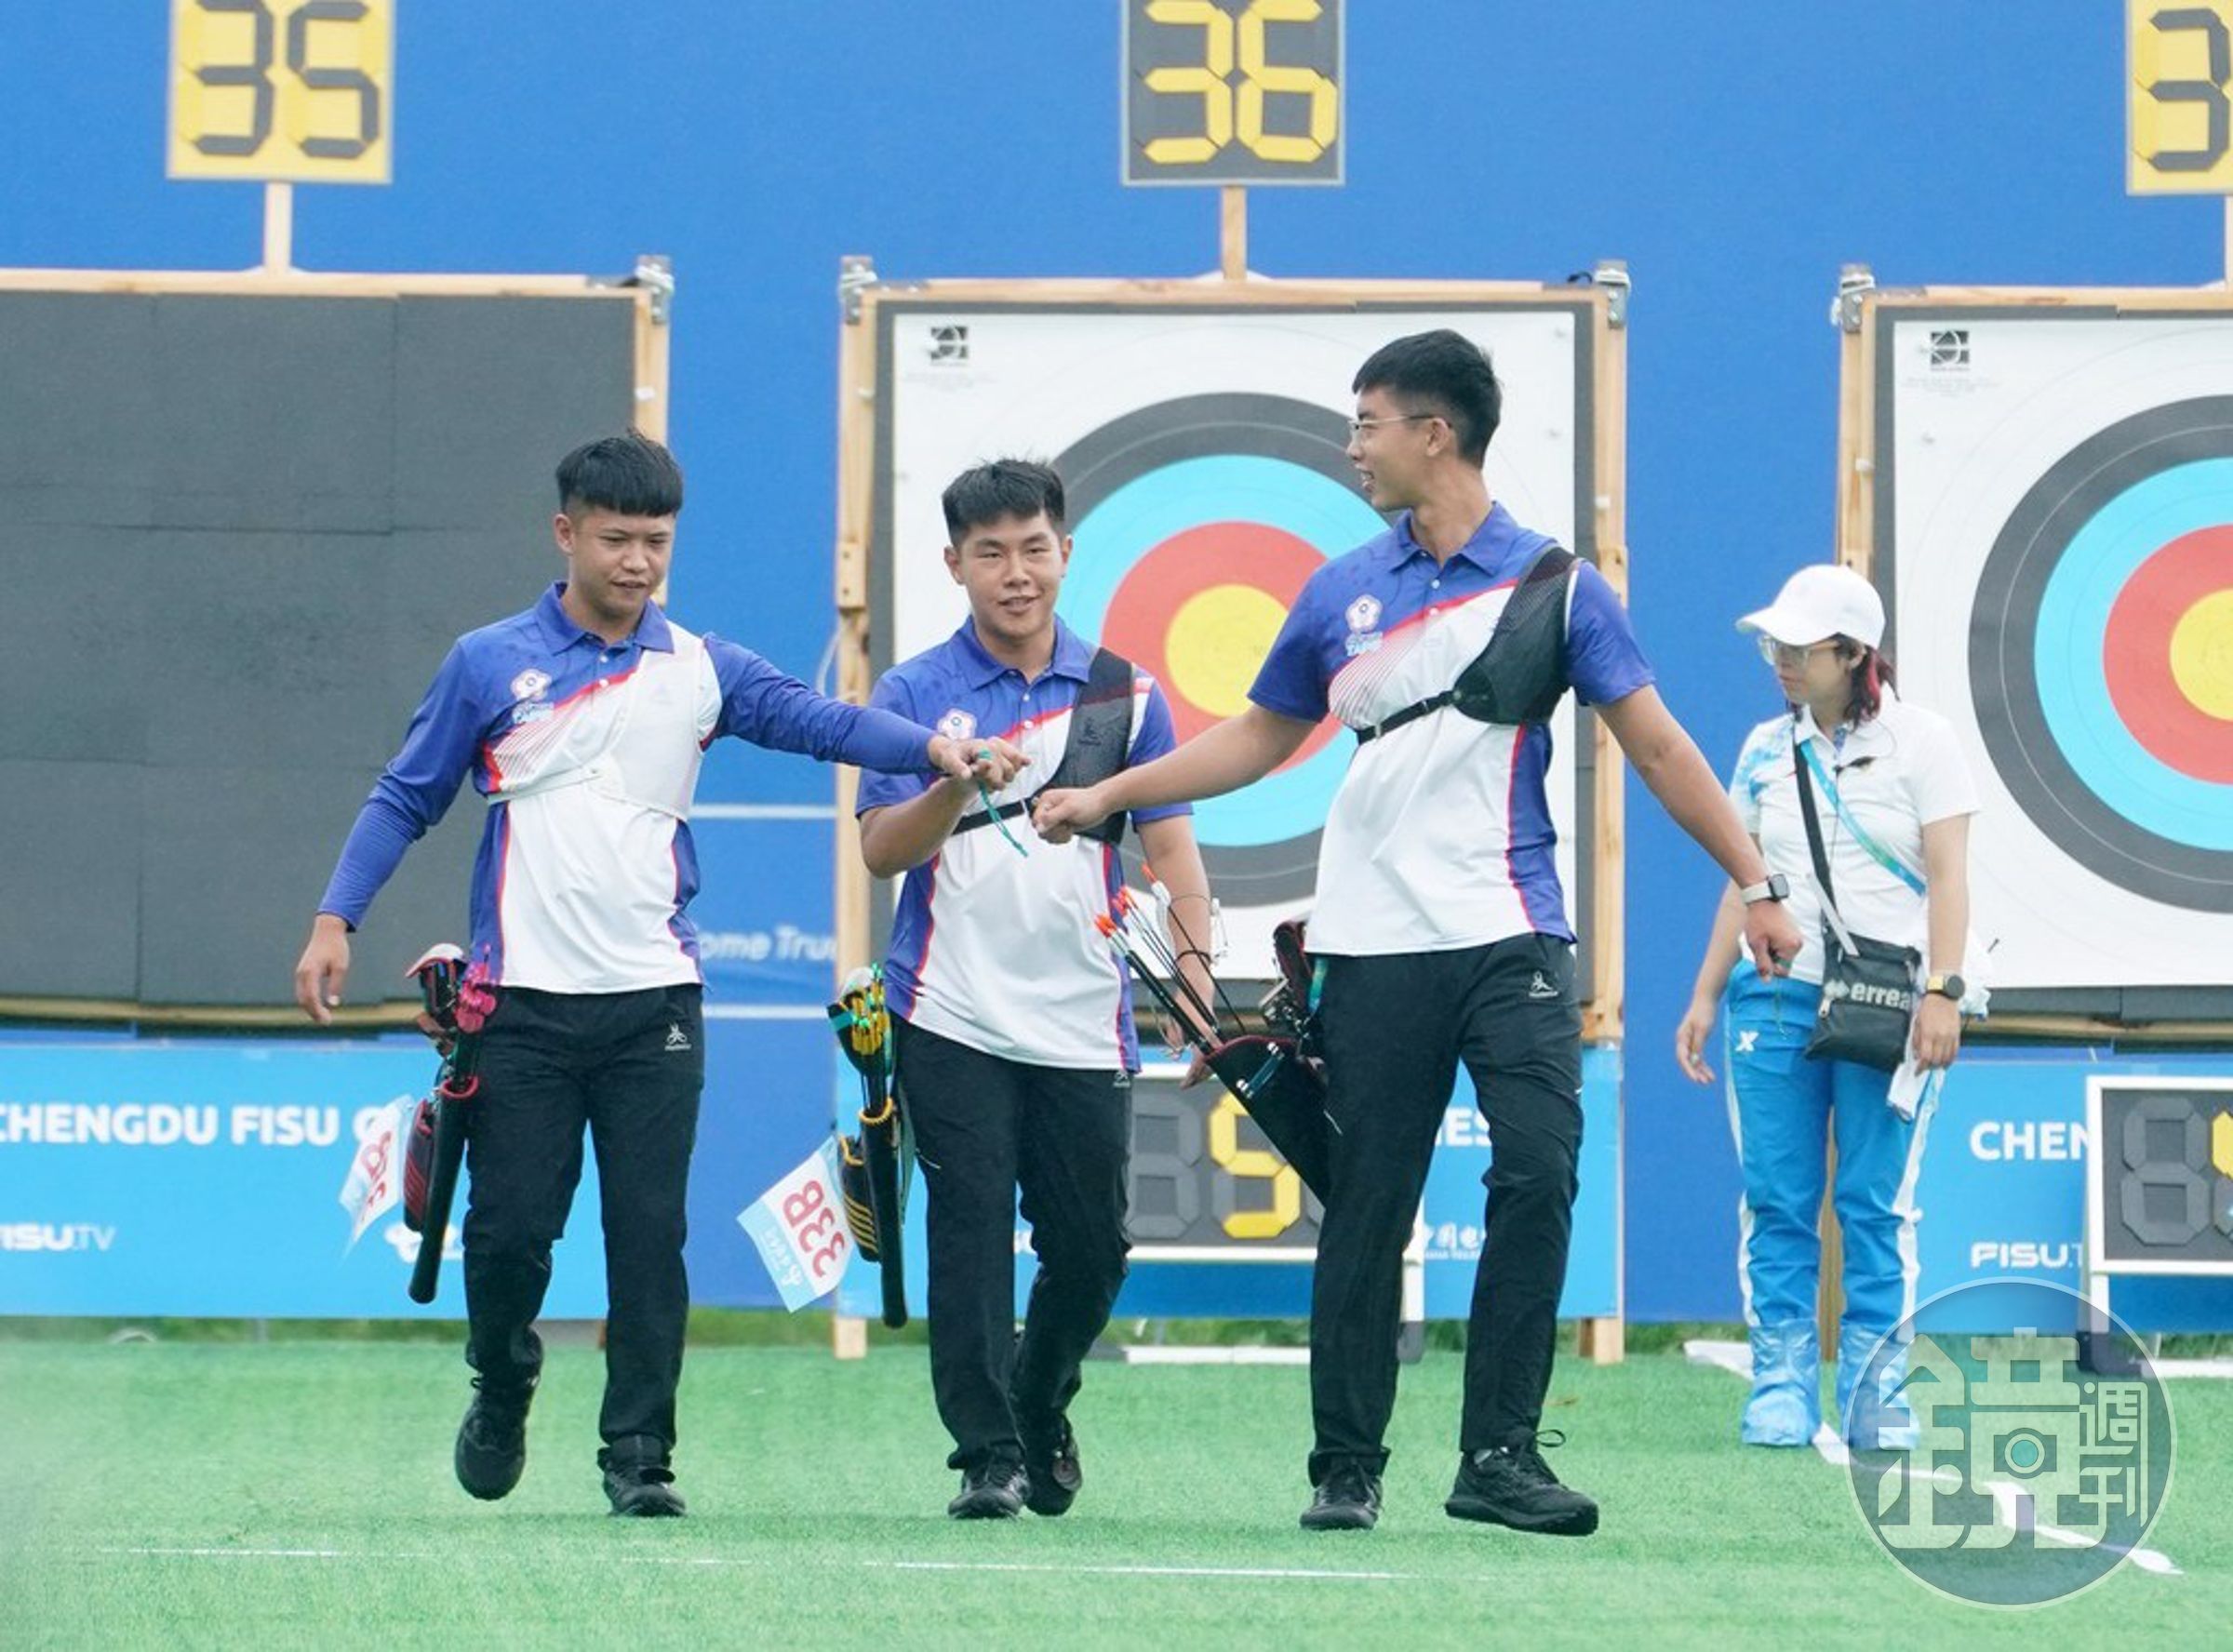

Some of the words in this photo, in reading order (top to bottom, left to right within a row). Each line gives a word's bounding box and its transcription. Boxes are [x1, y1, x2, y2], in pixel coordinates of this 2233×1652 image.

[194, 0, 381, 159] 35
[1143, 0, 1339, 164] 36
[0, 1102, 220, 1145] HENGDU
[231, 1105, 341, 1146] FISU
[1435, 1107, 1492, 1147] ES
[0, 1222, 116, 1251] ISU.TV
